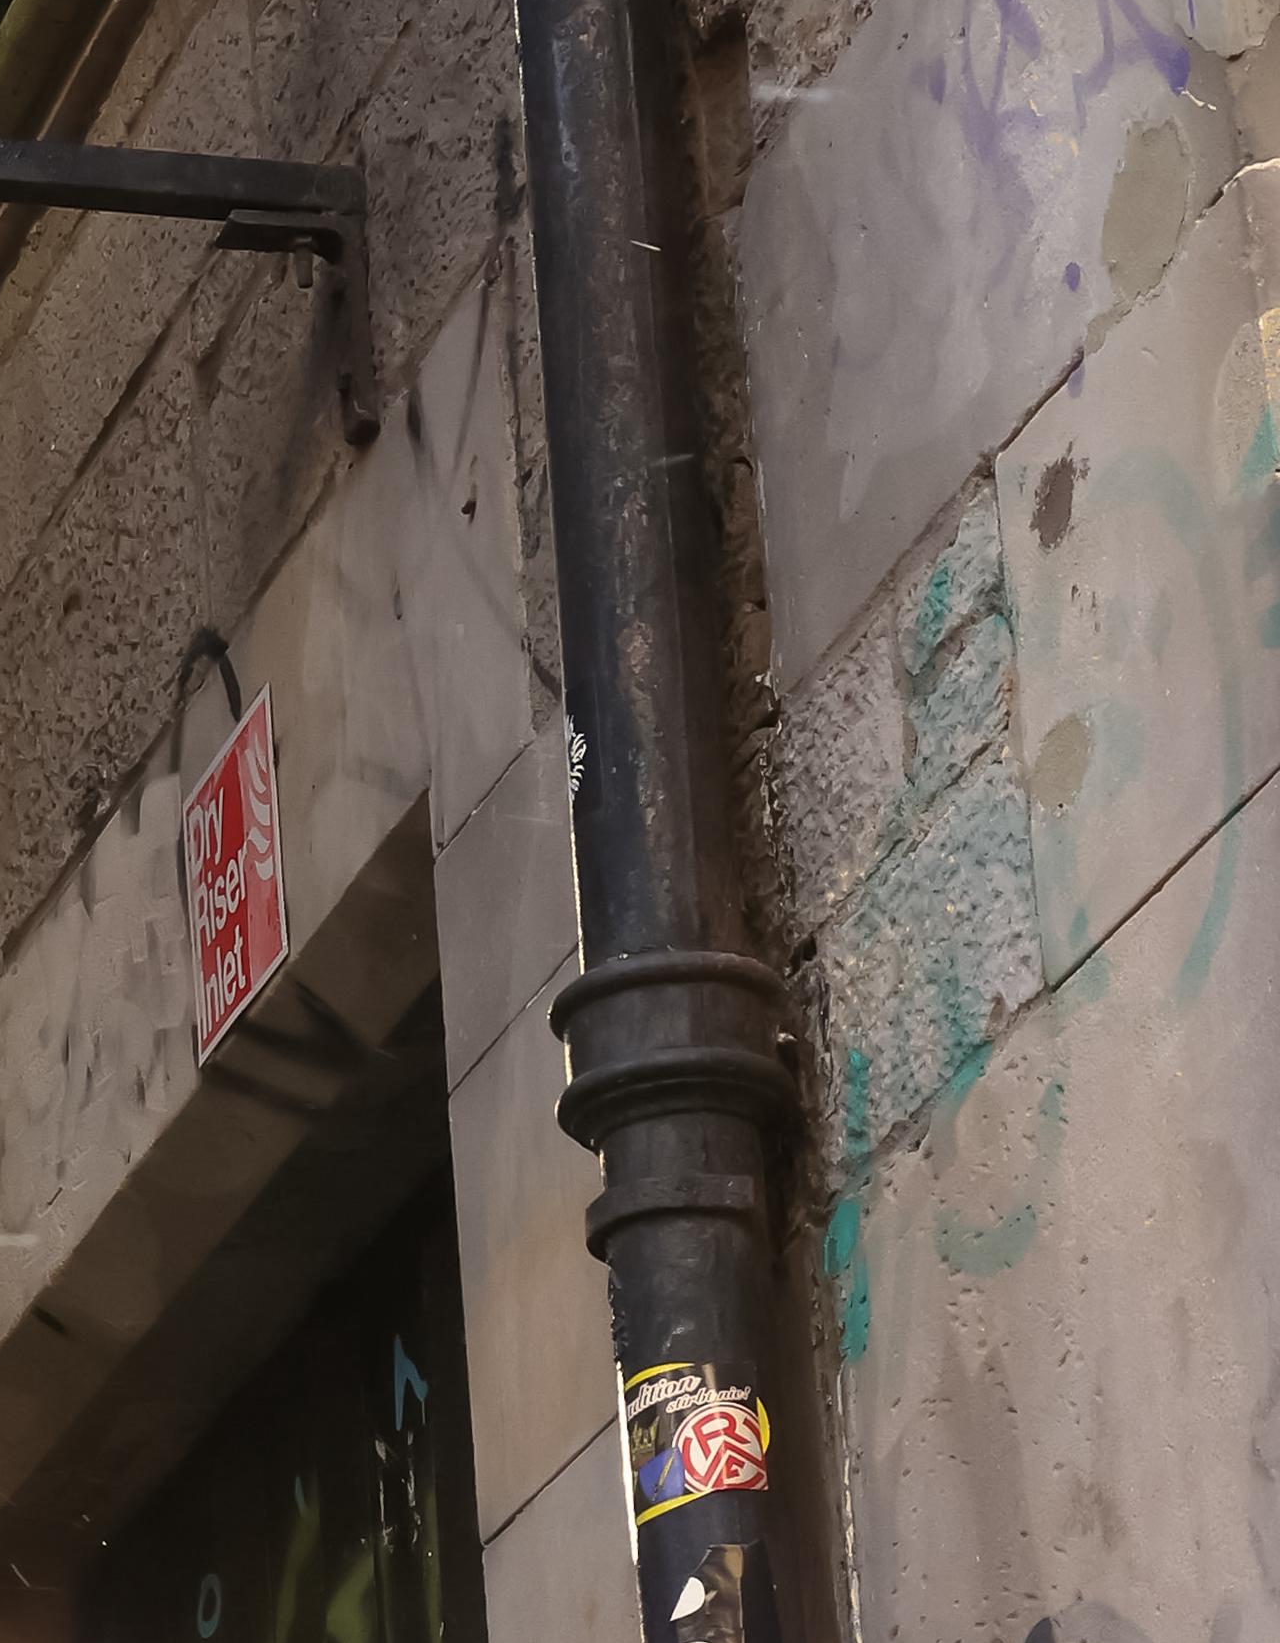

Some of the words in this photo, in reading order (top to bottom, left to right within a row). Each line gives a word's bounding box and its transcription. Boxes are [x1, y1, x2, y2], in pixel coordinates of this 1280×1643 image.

[189, 787, 223, 876] Dry
[193, 846, 246, 947] Riser
[199, 924, 245, 1040] Inlet
